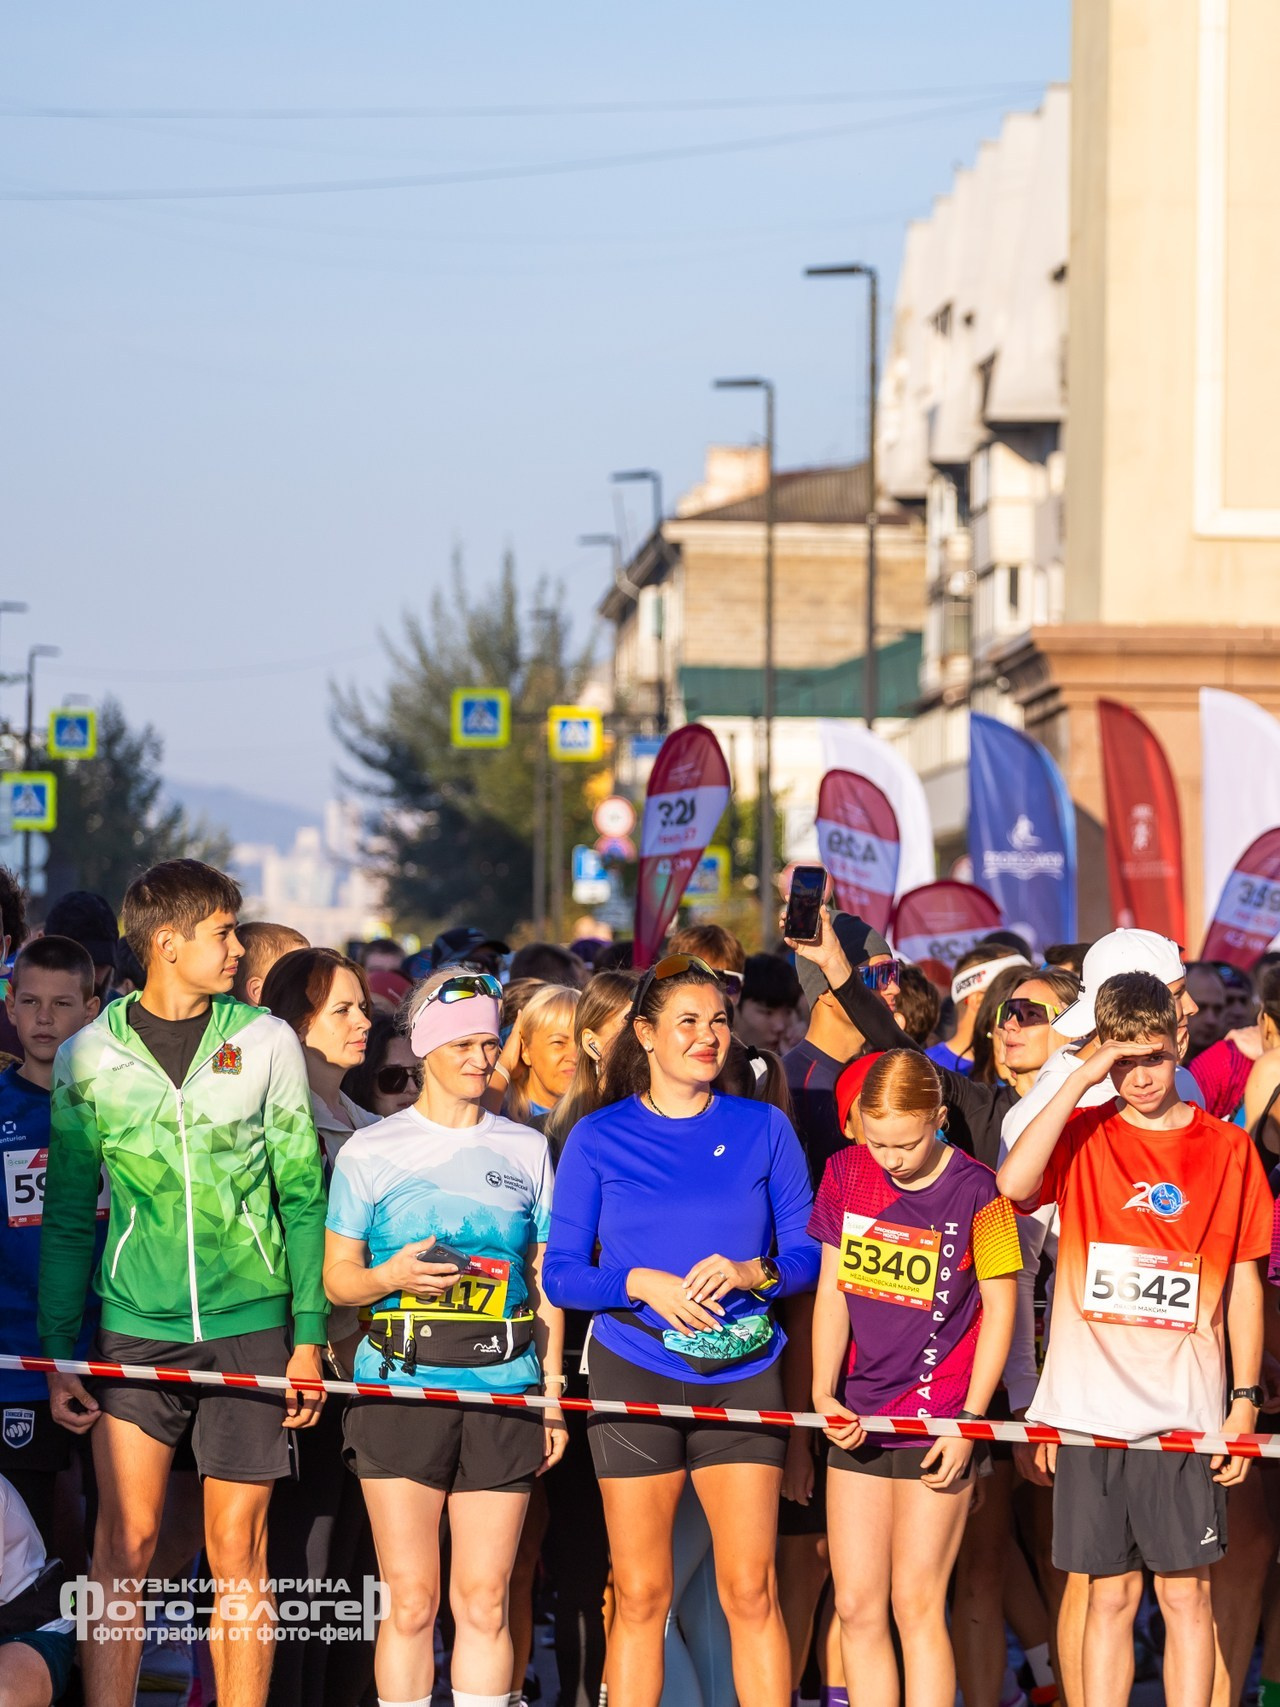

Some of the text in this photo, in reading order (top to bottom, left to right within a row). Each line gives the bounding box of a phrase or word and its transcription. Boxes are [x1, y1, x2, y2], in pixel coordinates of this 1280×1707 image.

[0, 1134, 27, 1144] enturion
[843, 1239, 931, 1285] 5340
[898, 1284, 920, 1293] МАРИЯ
[1092, 1269, 1191, 1309] 5642
[1137, 1305, 1168, 1314] МАКСИМ
